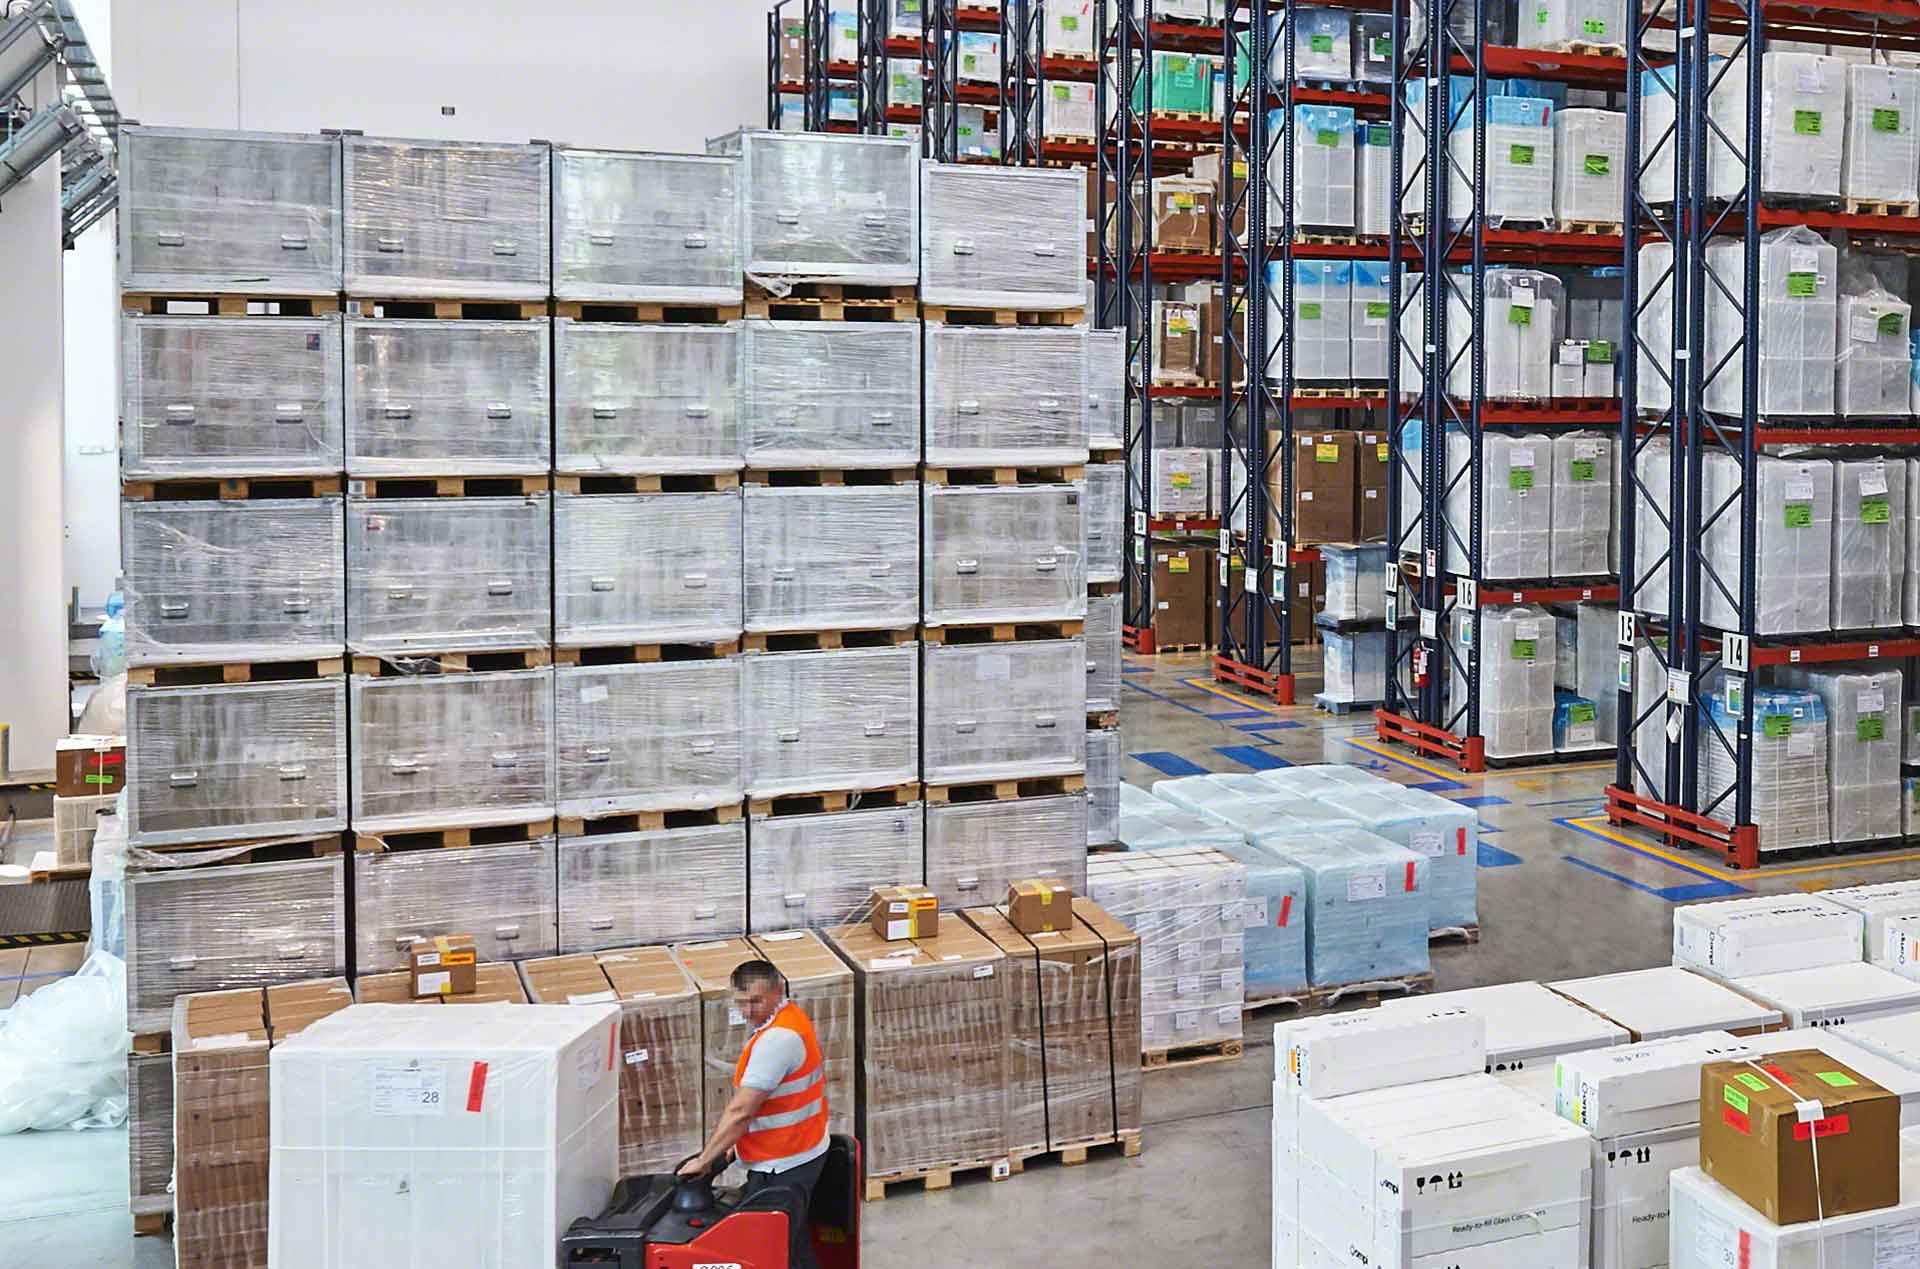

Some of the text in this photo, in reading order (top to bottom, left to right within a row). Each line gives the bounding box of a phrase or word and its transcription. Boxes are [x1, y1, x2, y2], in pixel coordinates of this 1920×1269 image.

[1387, 566, 1396, 591] 17
[1462, 582, 1473, 607] 16
[1621, 615, 1633, 642] 15
[1728, 637, 1743, 666] 14
[421, 1091, 441, 1104] 28
